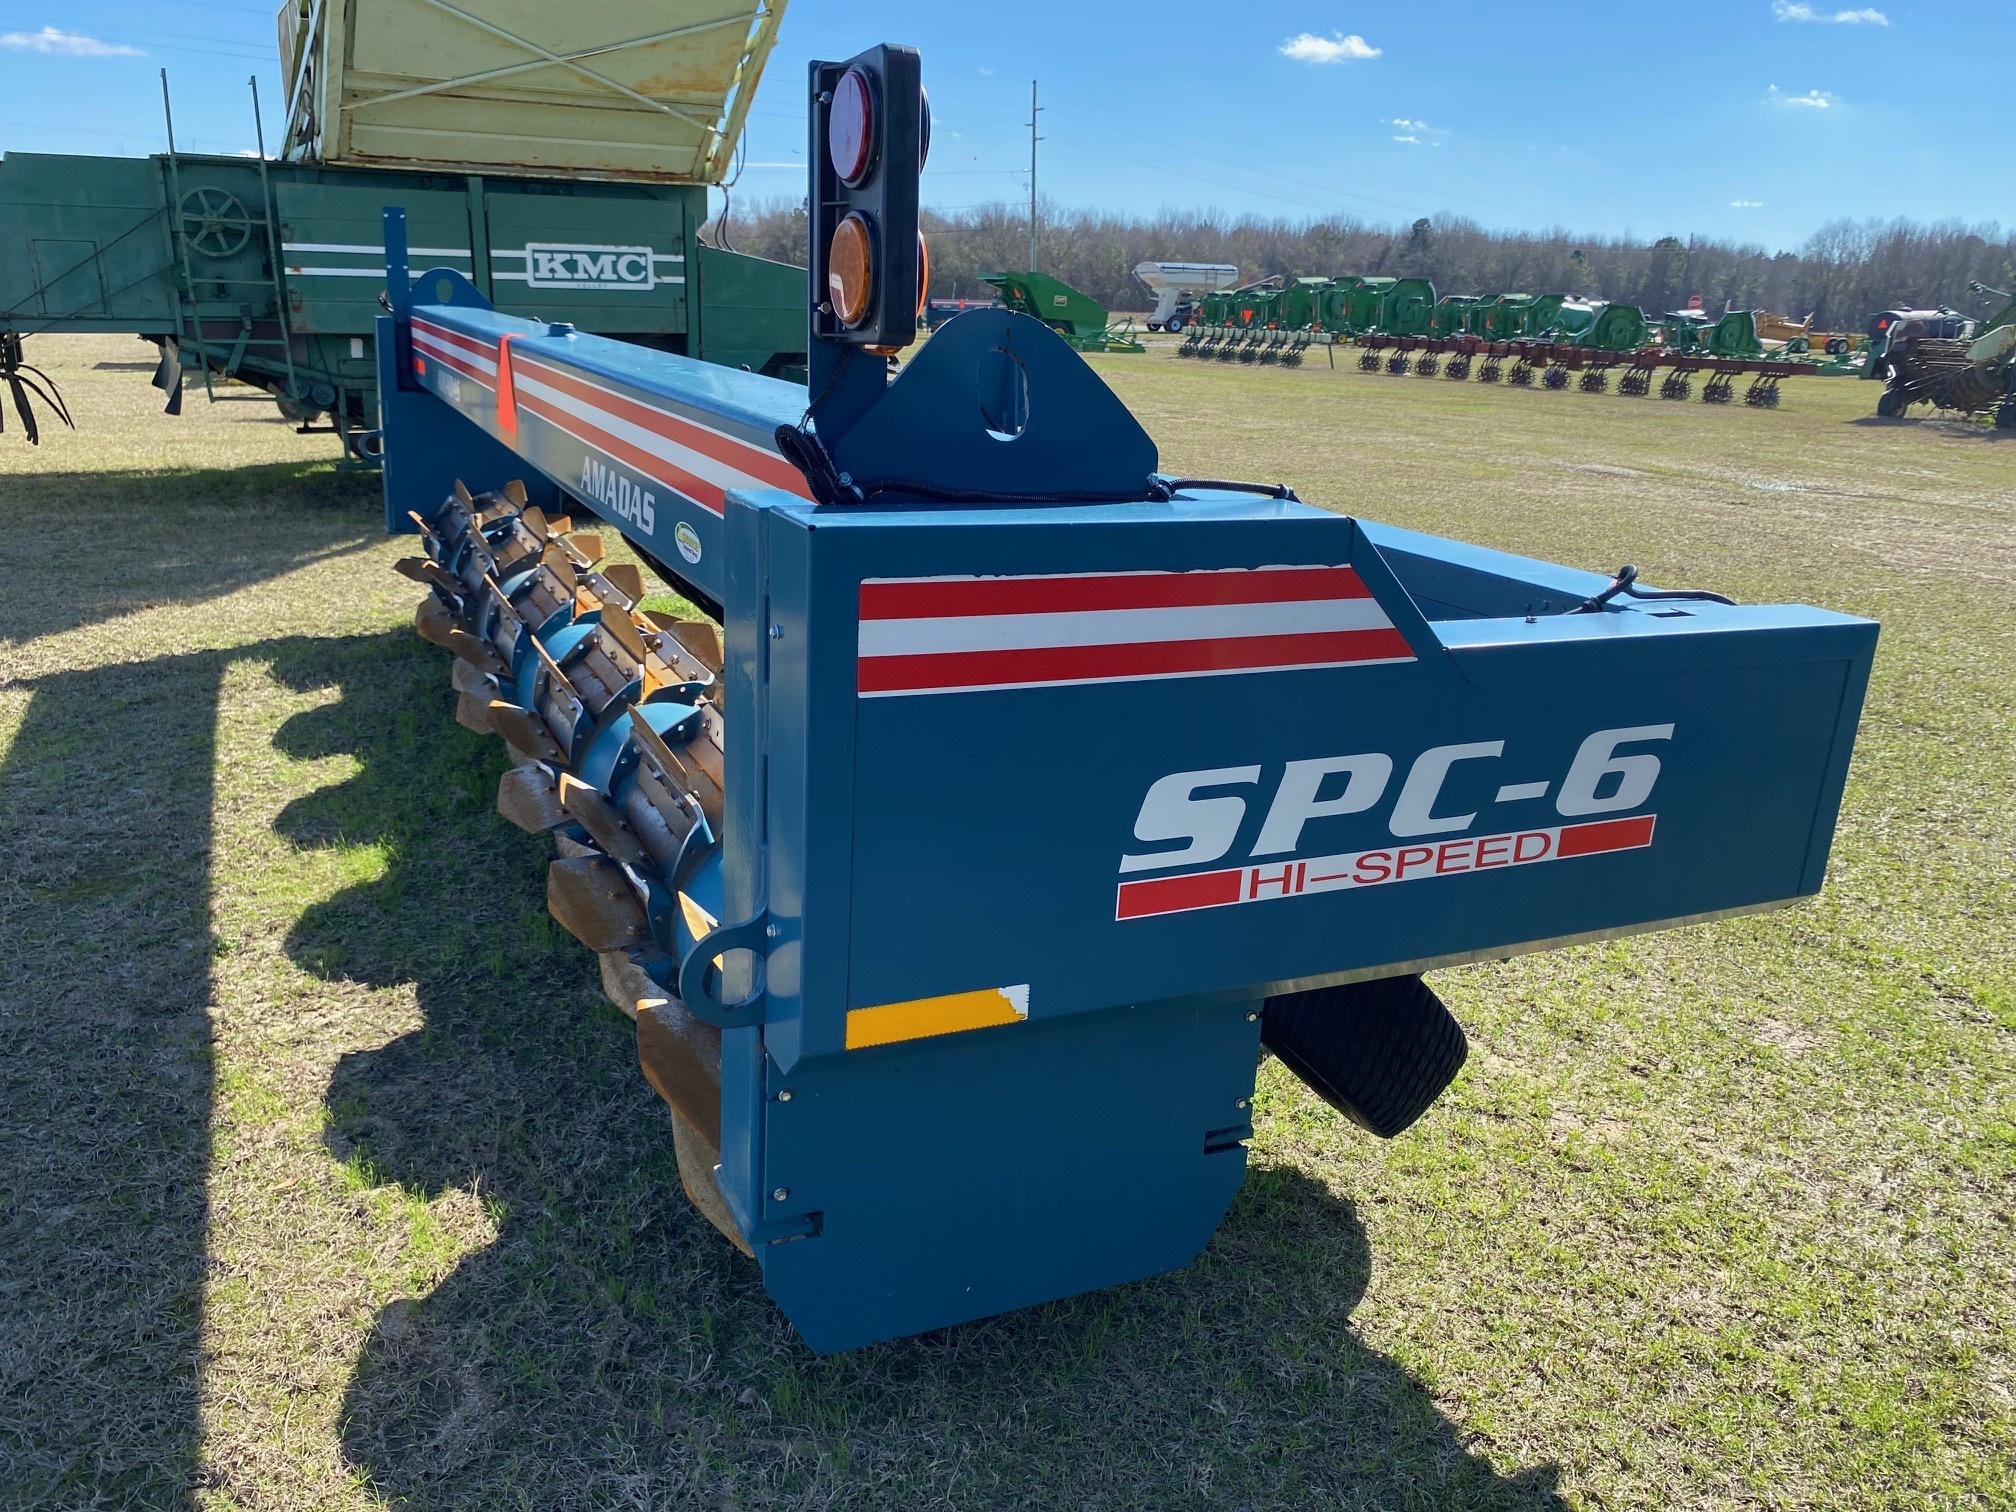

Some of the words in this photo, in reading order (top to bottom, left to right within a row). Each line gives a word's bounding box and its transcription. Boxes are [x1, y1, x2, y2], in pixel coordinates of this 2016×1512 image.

[533, 252, 647, 282] KMC
[580, 455, 656, 536] AMADAS
[1118, 723, 1676, 874] SPC-6
[1249, 831, 1552, 900] HI-SPEED
